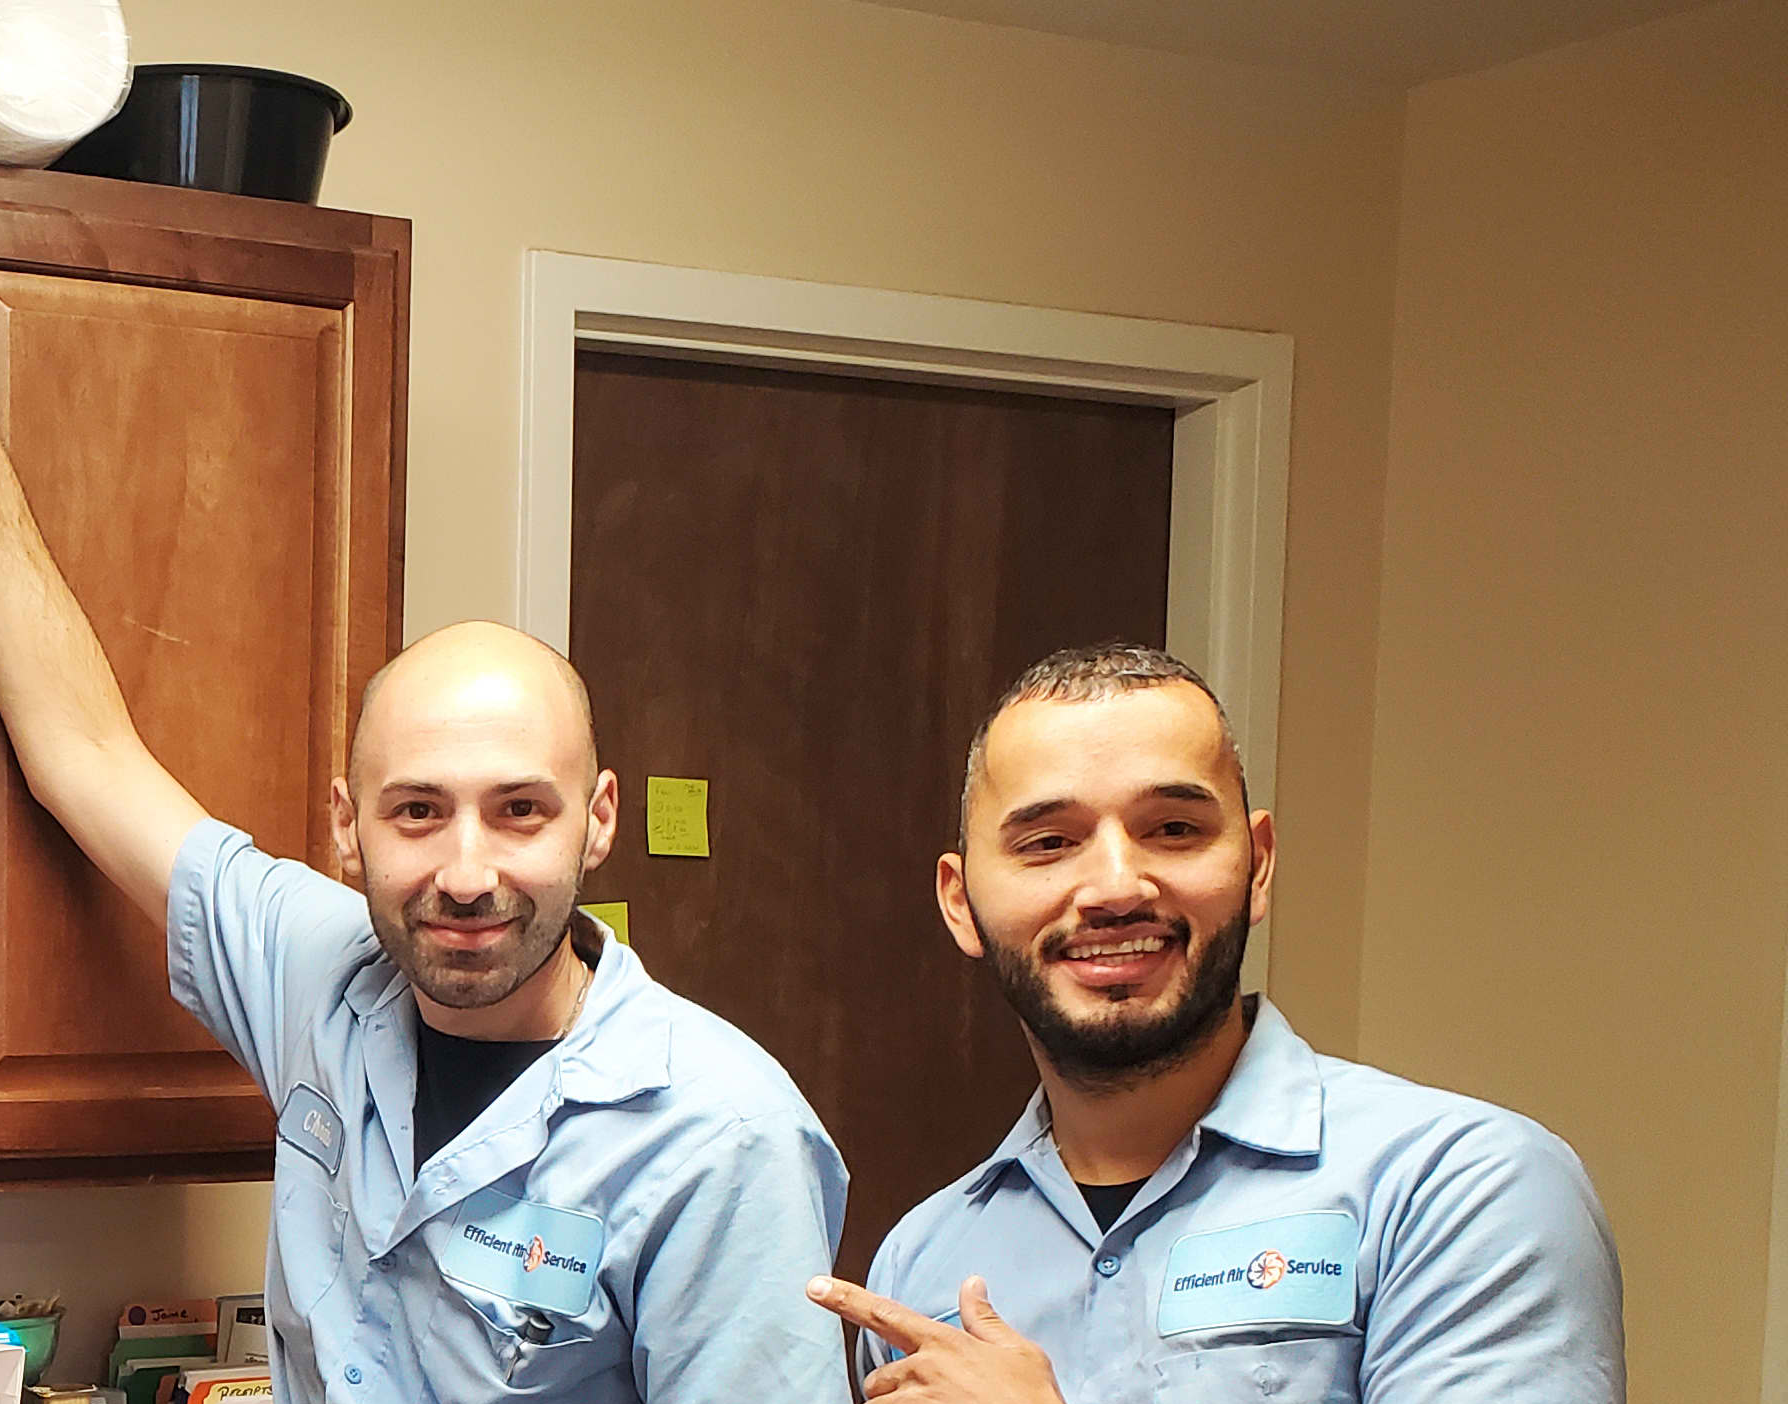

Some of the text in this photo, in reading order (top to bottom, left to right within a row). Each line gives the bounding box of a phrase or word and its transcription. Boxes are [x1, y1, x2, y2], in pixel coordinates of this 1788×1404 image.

[463, 1224, 512, 1256] Efficient
[542, 1251, 587, 1274] Service
[1173, 1258, 1342, 1292] Efficient Air Service
